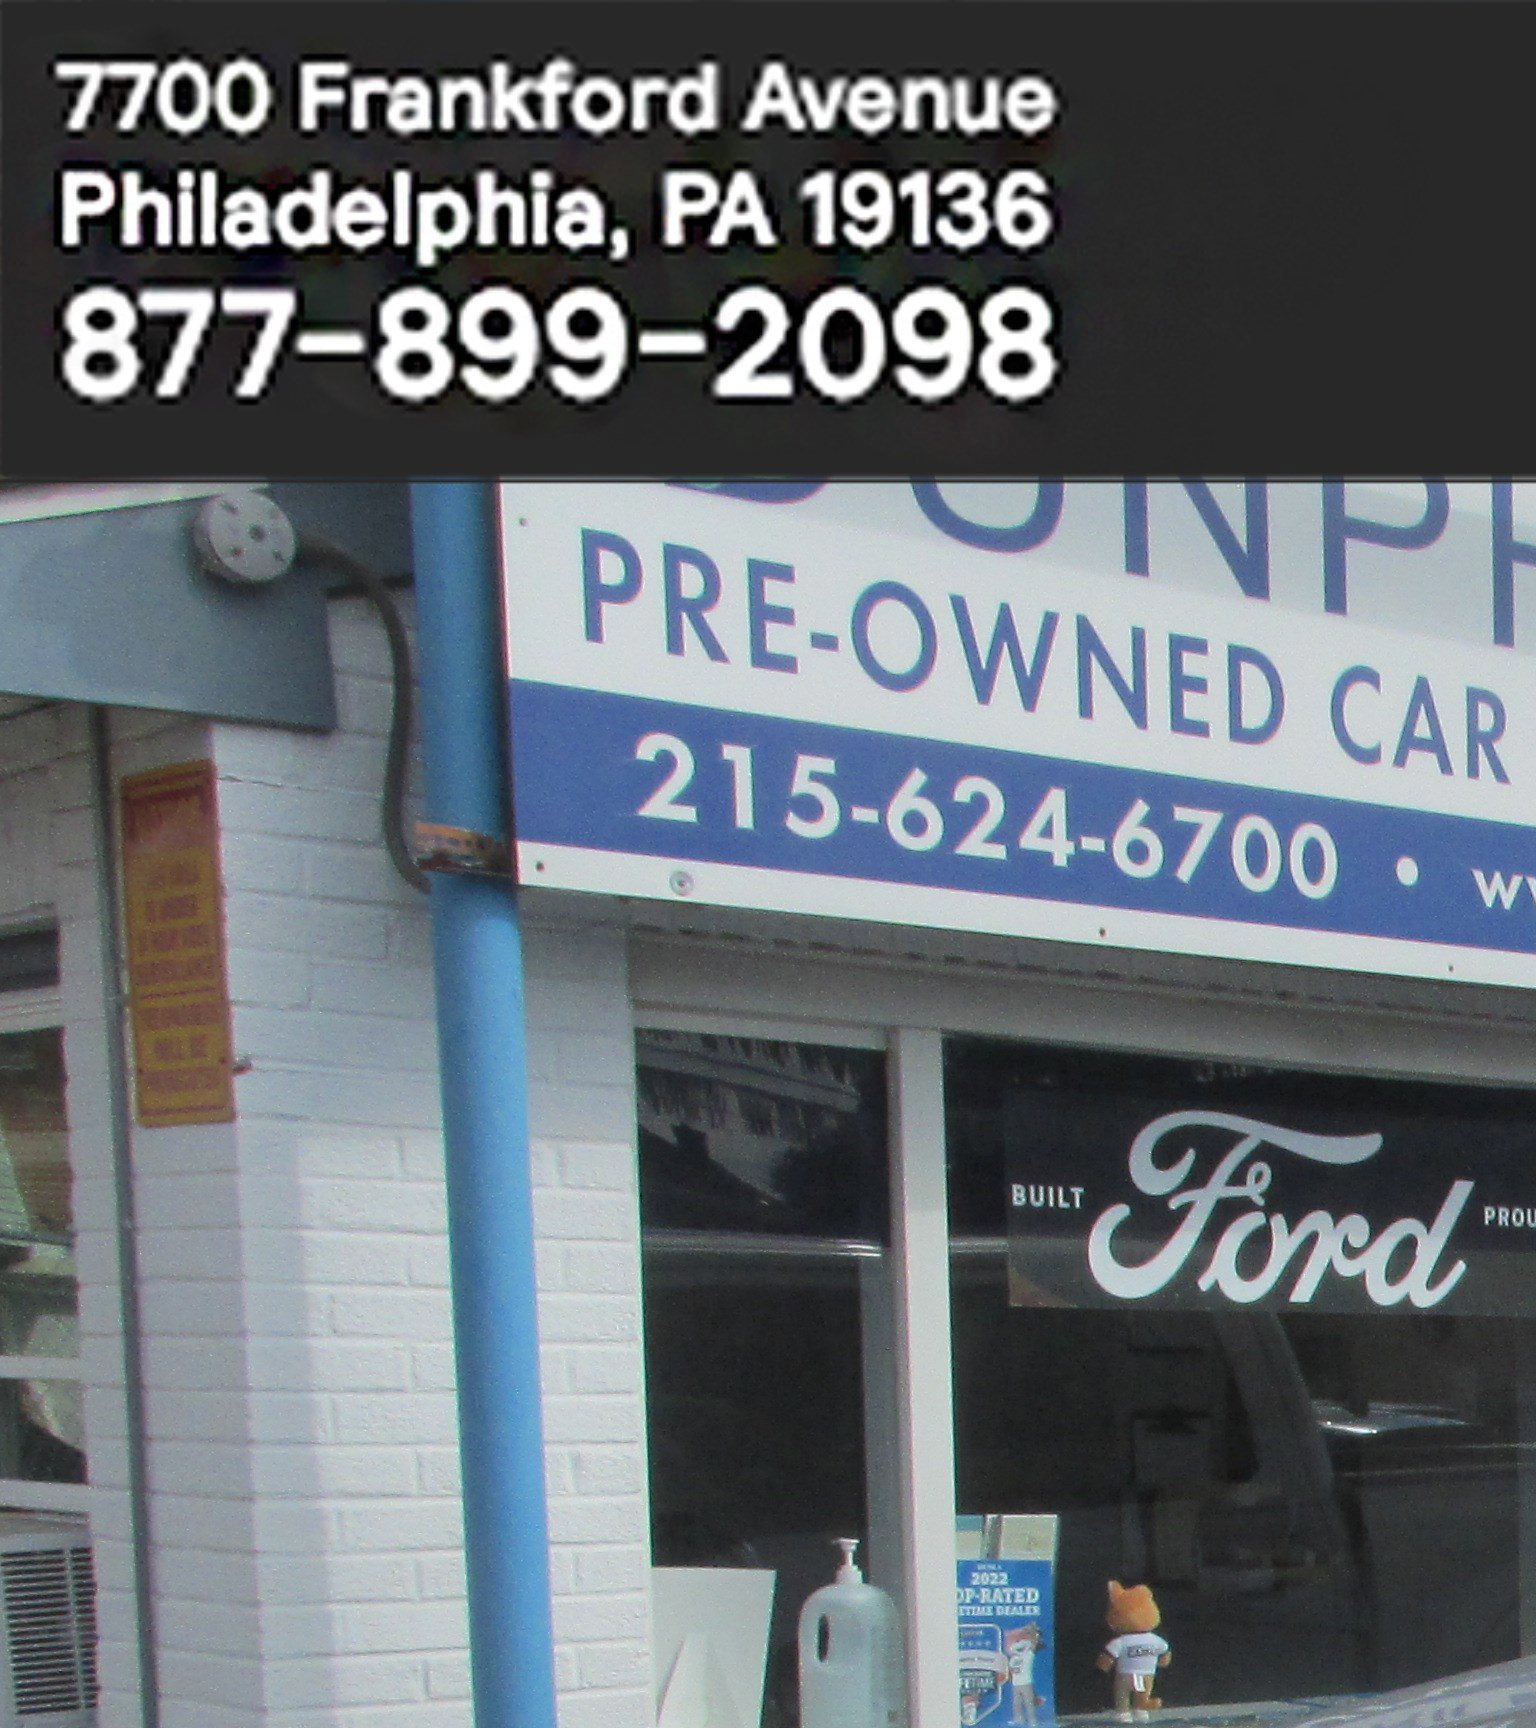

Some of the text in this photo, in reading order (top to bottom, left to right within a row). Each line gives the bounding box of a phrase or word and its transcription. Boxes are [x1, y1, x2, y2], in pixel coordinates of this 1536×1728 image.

[580, 527, 1286, 746] PRE-OWNED
[1330, 664, 1511, 785] CAR
[634, 732, 1339, 900] 215-624-6700
[1010, 1183, 1084, 1210] BUILT
[1088, 1109, 1475, 1309] Ford
[956, 1587, 1040, 1603] OP-RATED
[970, 1572, 1008, 1585] 2022
